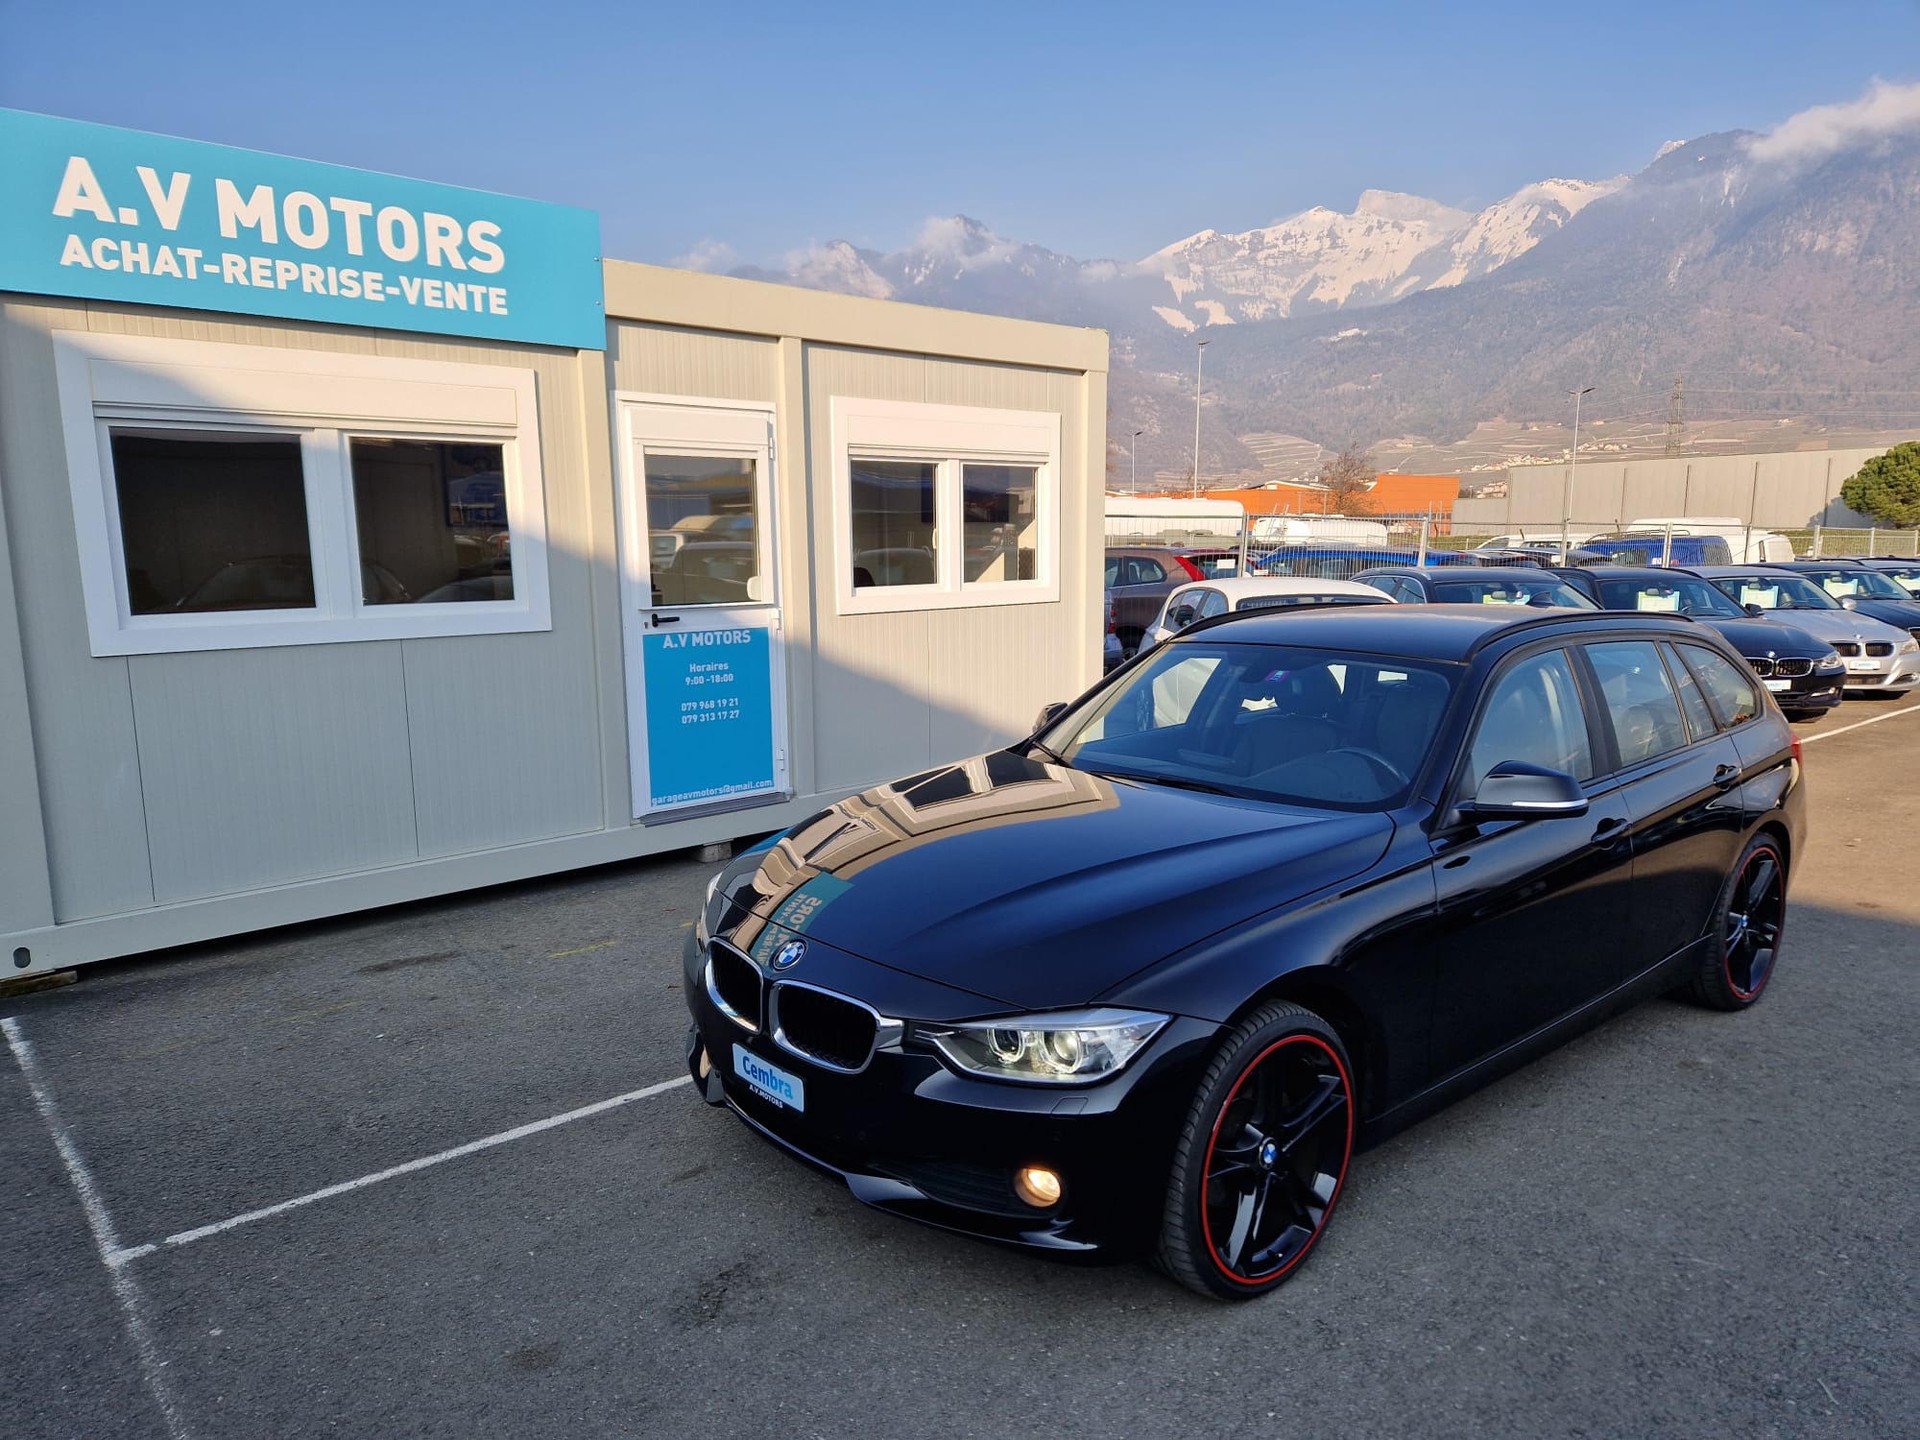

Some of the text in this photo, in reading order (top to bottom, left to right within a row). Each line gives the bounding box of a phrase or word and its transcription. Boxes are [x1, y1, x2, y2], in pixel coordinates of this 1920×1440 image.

[52, 156, 506, 274] A.V MOTORS
[59, 234, 508, 316] ACHAT-REPRISE-VENTE
[662, 630, 751, 649] A.V MOTORS
[690, 662, 729, 673] Horaires
[685, 676, 704, 686] 9:00
[681, 698, 739, 712] 079 968 19 21
[681, 710, 740, 725] 079 313 17 27
[651, 779, 773, 806] garageavmotors@gmail.com
[743, 1055, 793, 1100] Cembra
